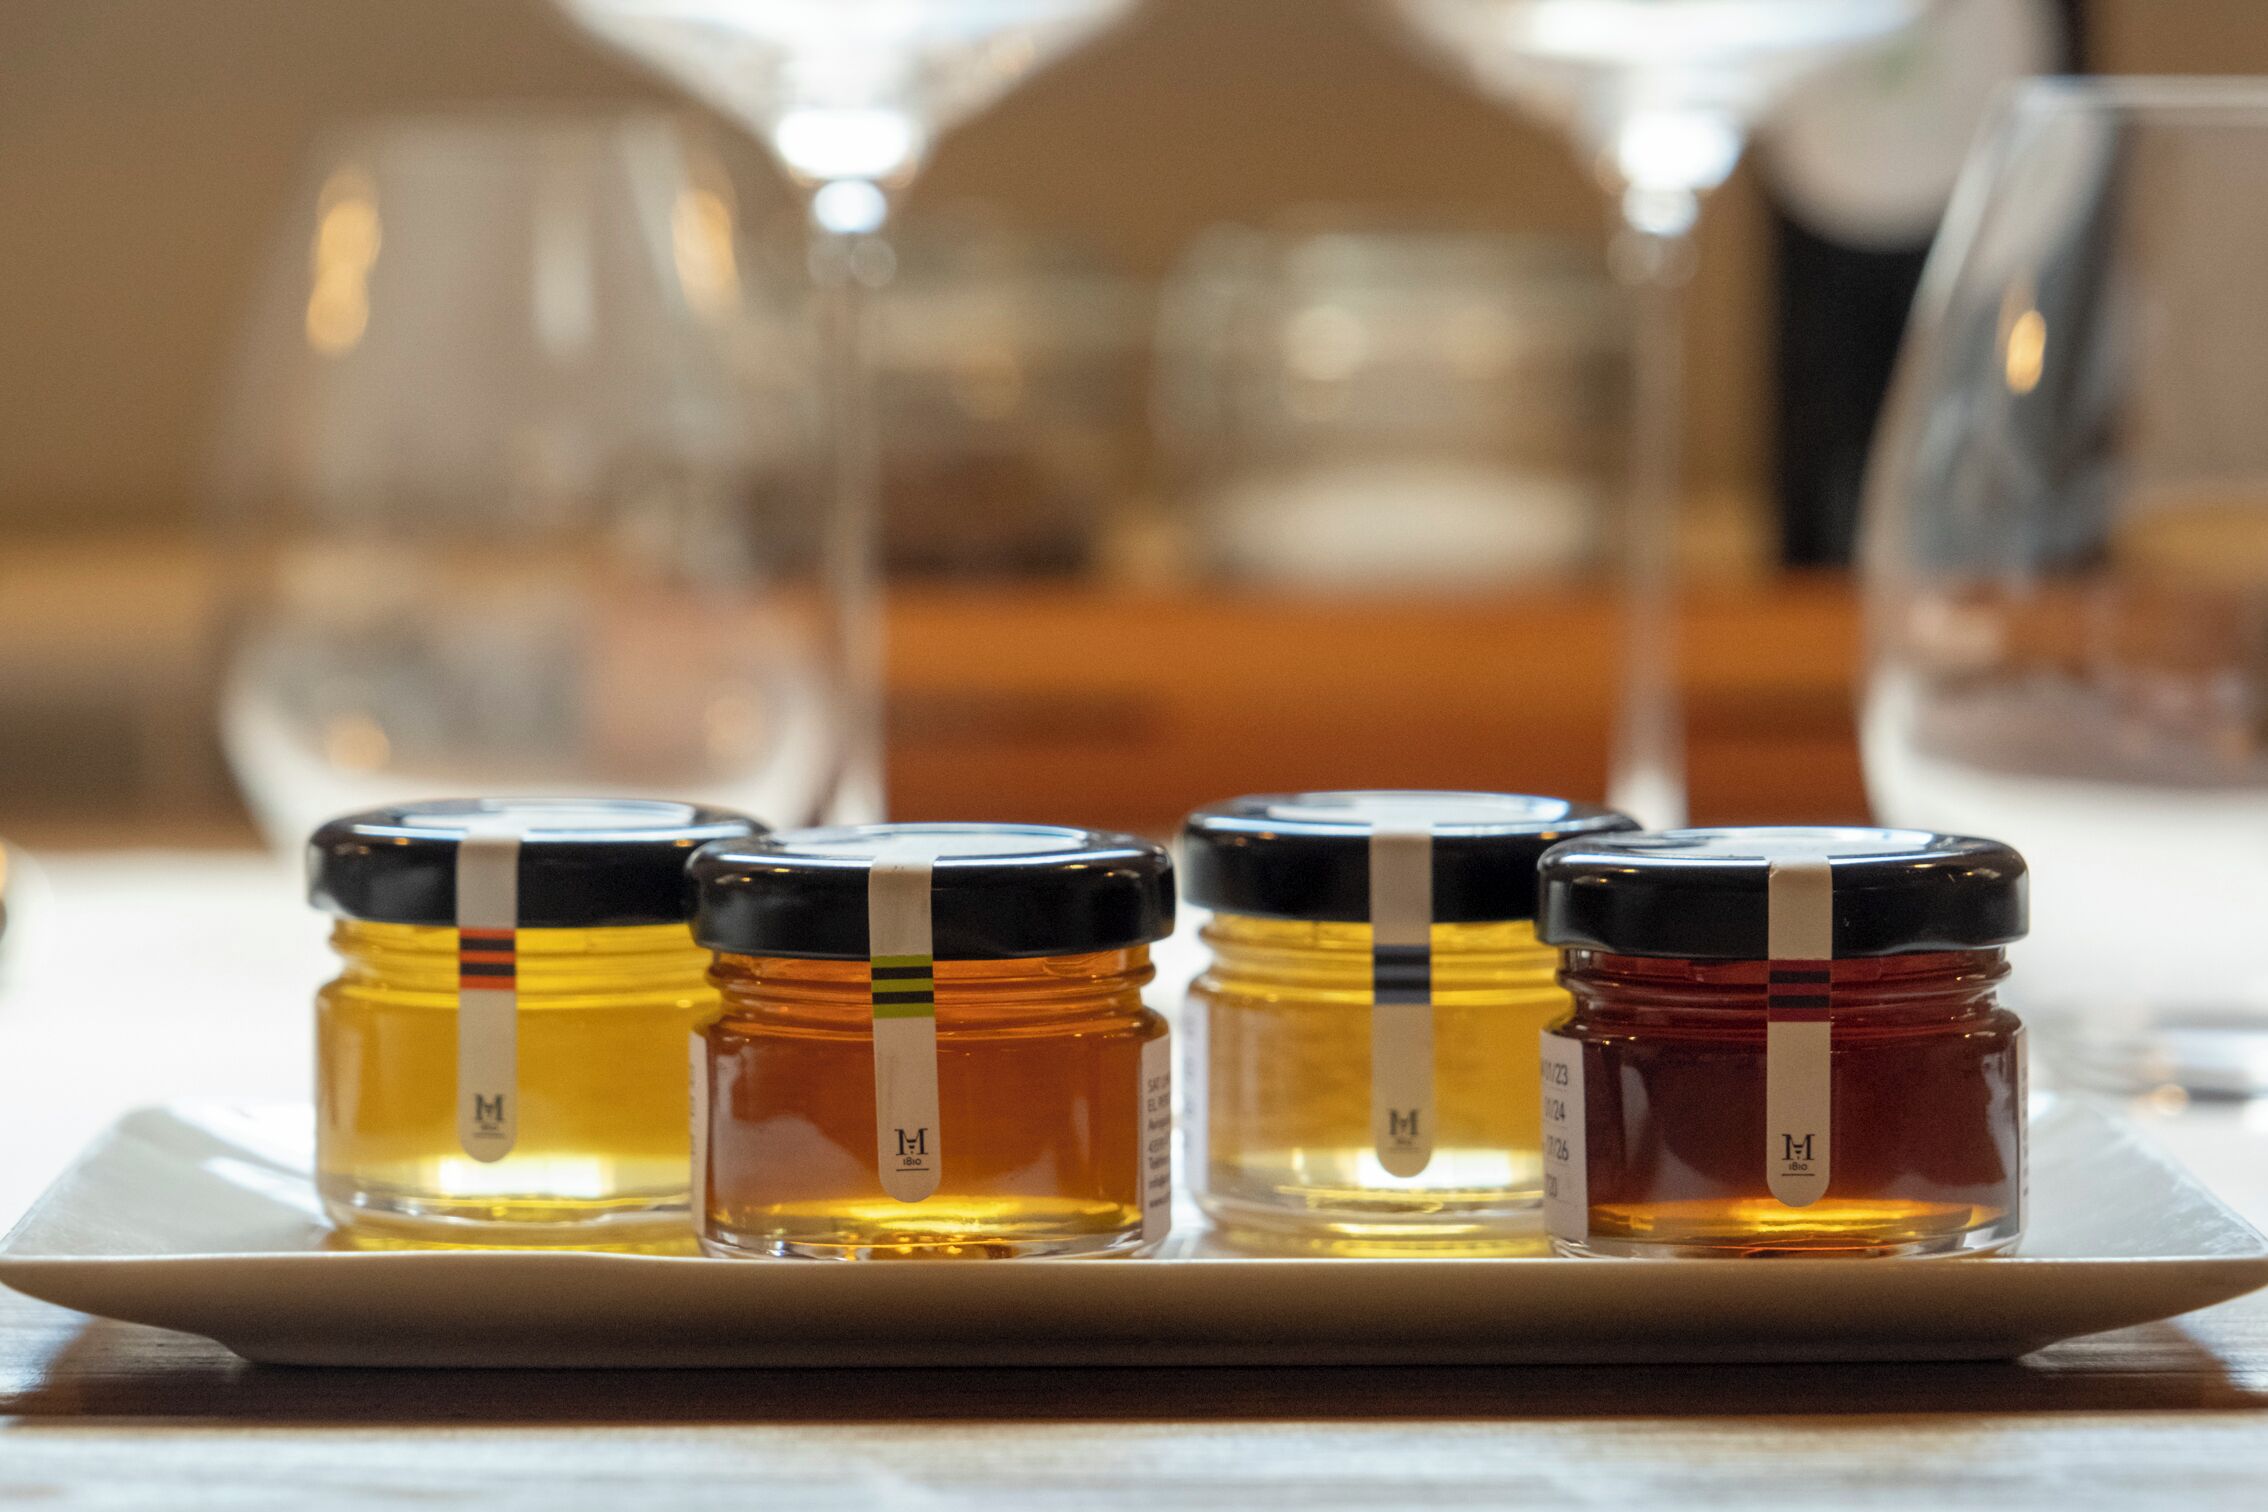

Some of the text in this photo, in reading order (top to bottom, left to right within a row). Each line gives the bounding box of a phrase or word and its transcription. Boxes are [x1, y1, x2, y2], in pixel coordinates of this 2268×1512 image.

[474, 1093, 506, 1123] M
[1388, 1109, 1420, 1136] M
[894, 1128, 928, 1156] M
[1781, 1133, 1815, 1161] M
[903, 1156, 922, 1166] 1810
[1788, 1161, 1808, 1171] 1810
